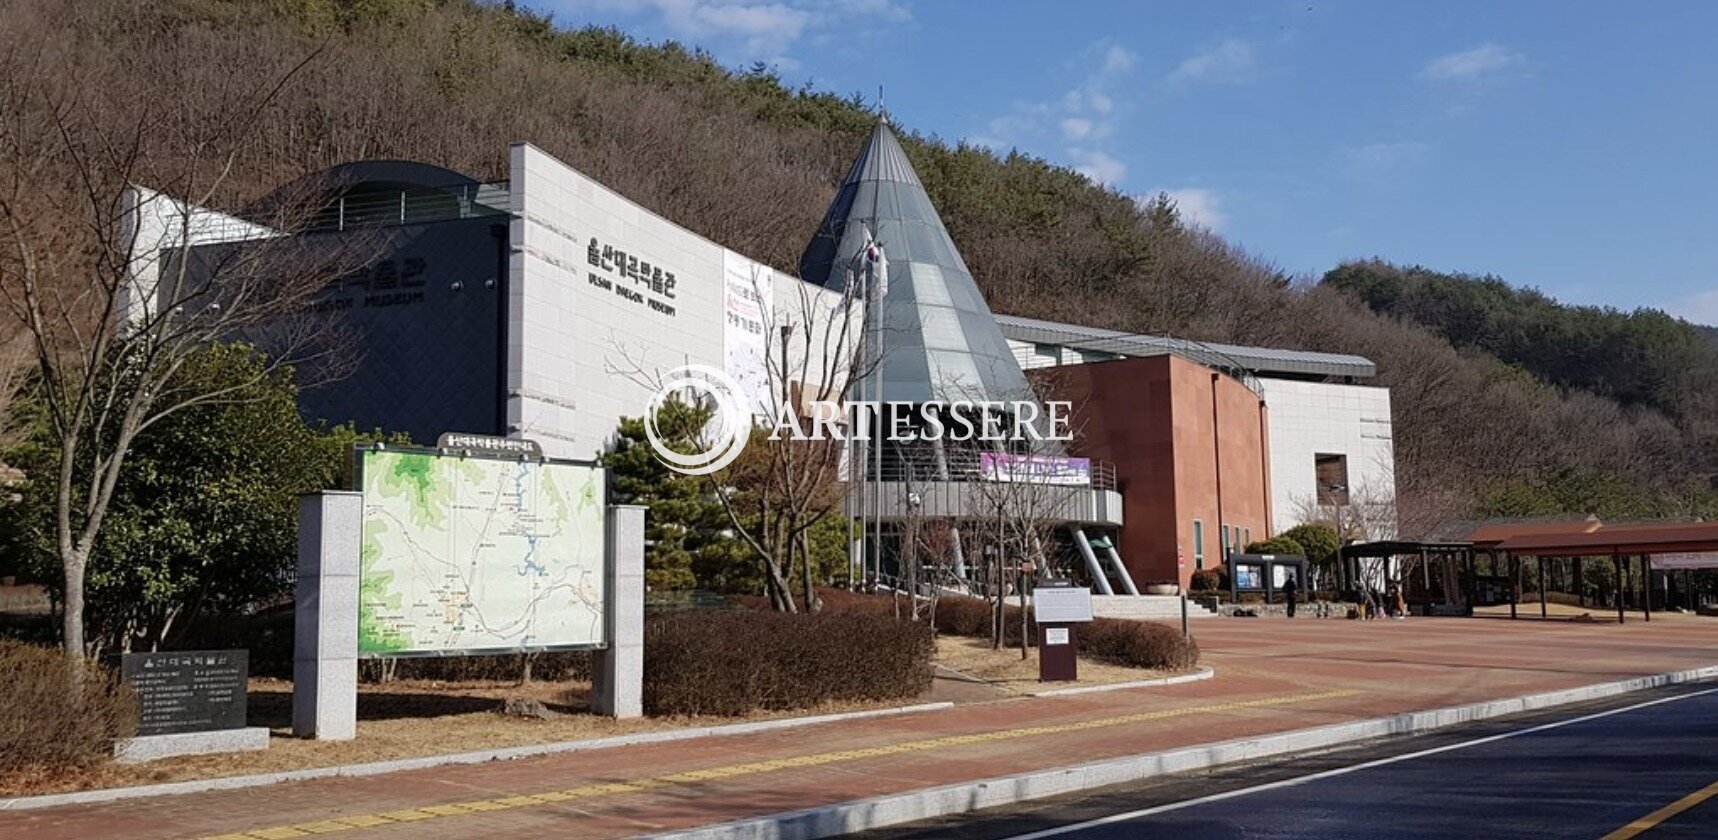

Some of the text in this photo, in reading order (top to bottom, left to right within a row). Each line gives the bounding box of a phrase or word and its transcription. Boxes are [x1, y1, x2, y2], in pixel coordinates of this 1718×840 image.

[587, 237, 677, 299] 울산대곡박물관
[364, 292, 425, 308] MUSEUM
[588, 272, 676, 317] ULSAN DAEGOK MUSEUM
